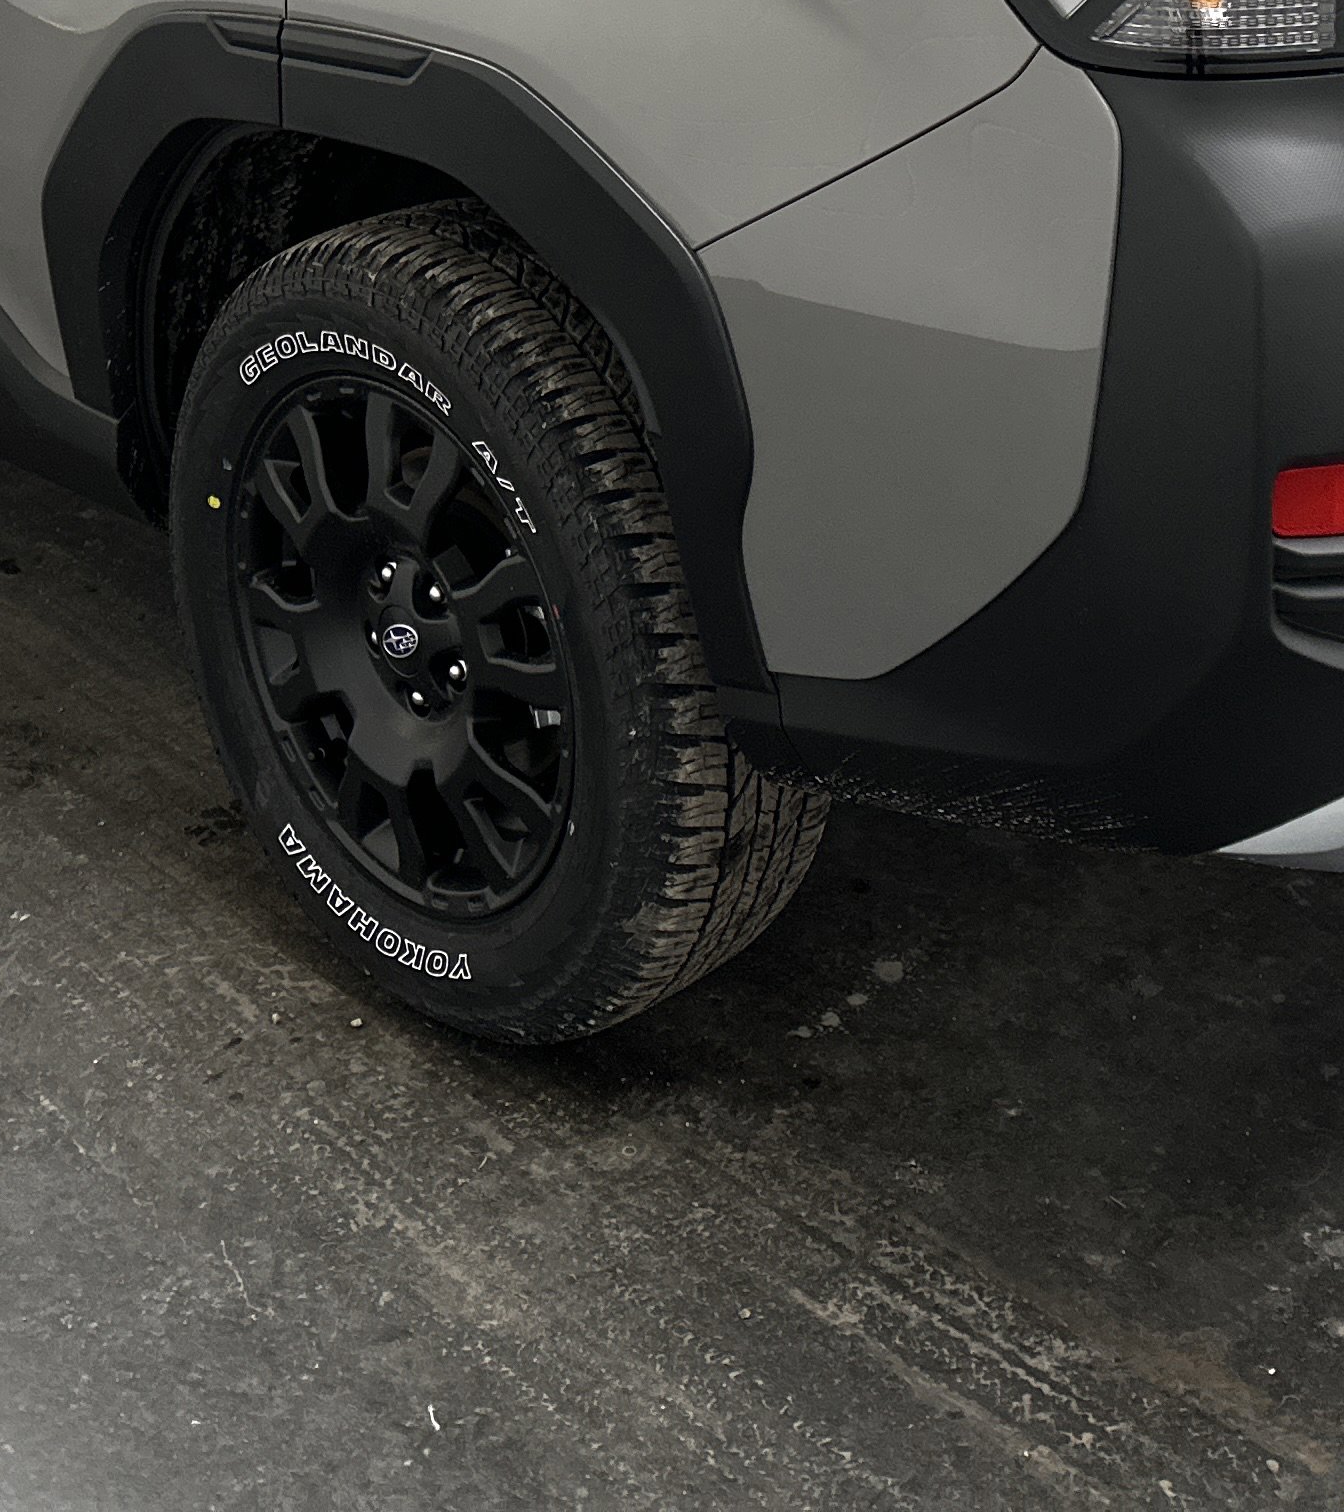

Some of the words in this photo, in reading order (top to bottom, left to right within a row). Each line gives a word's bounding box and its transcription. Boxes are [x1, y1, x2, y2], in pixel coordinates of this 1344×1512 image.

[238, 329, 454, 418] GEOLANDAR
[470, 440, 537, 534] A/T
[278, 823, 473, 980] YOKOHAMA
